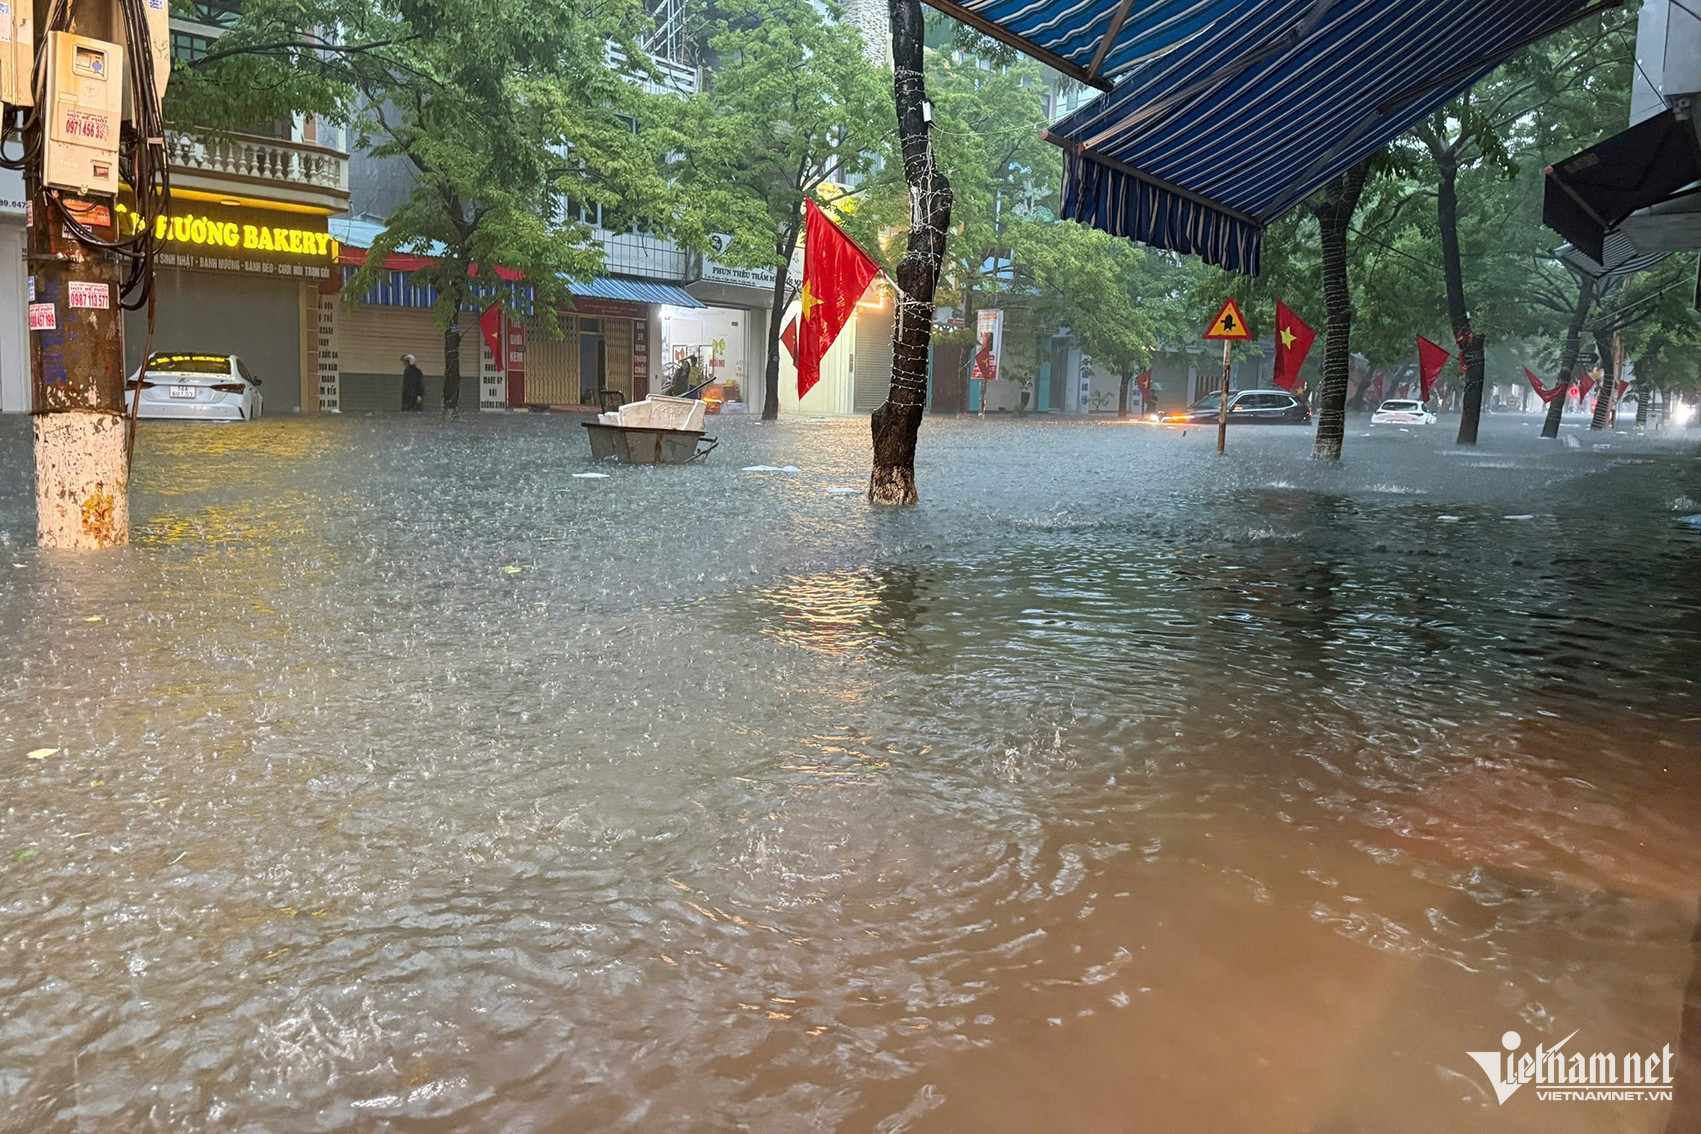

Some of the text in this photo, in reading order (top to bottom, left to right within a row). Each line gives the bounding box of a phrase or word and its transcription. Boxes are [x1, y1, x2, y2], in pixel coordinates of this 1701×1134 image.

[242, 224, 330, 256] BAKERY
[160, 253, 176, 265] SINH
[177, 253, 195, 268] NHẬT
[200, 257, 218, 271] BÁNH
[713, 266, 732, 276] PHUN
[732, 269, 751, 279] THÊU
[509, 351, 523, 363] KEM
[483, 376, 503, 384] MAKE UP
